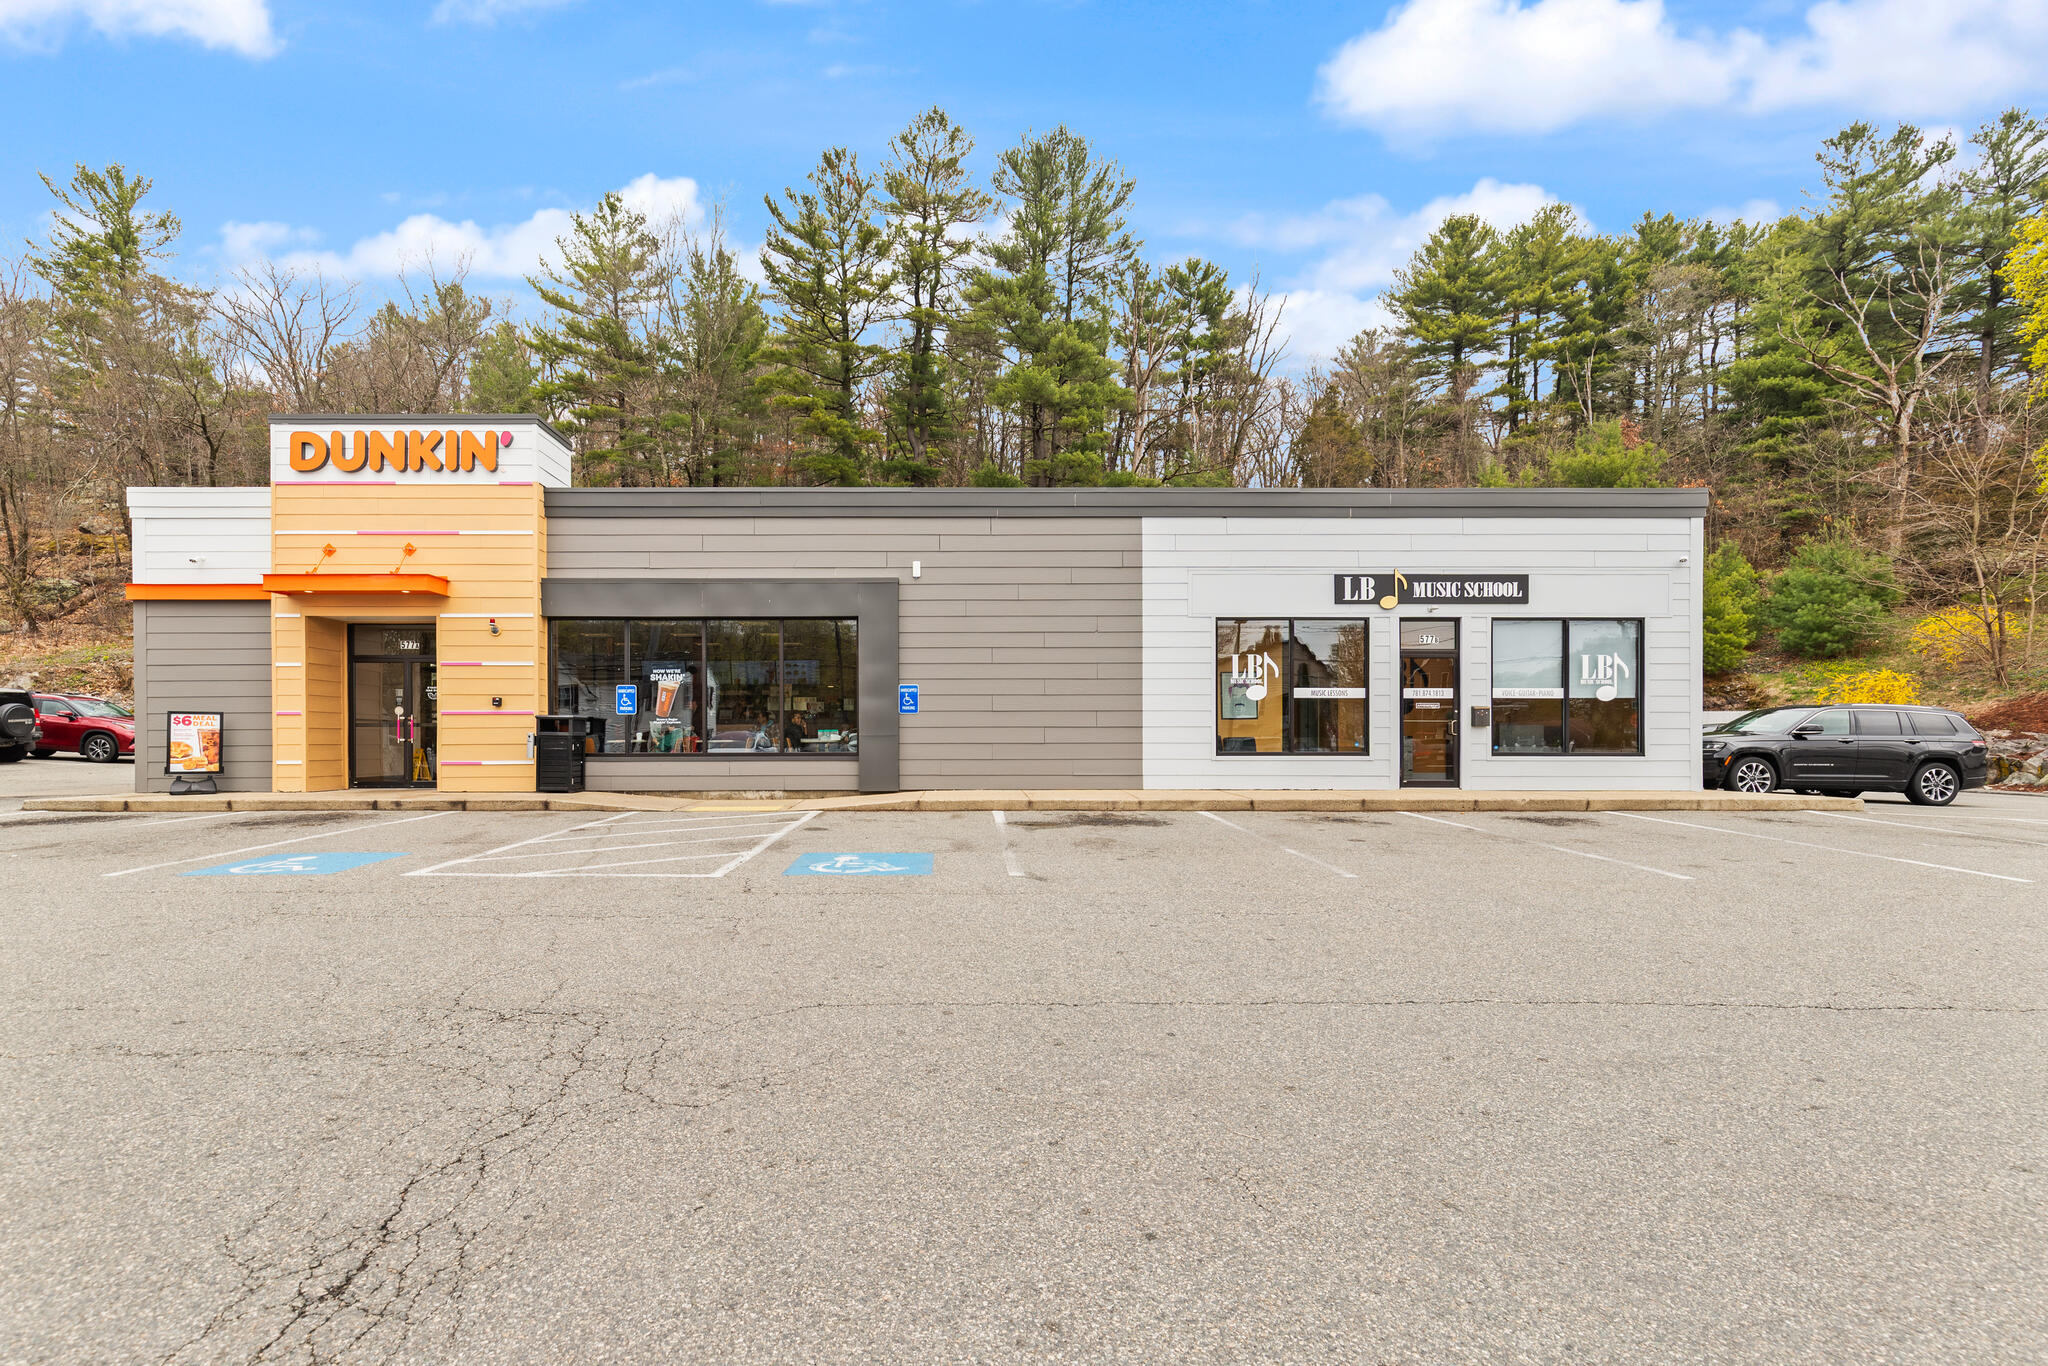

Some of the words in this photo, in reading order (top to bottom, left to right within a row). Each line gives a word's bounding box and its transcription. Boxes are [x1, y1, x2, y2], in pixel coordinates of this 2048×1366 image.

[290, 430, 513, 473] DUNKIN'
[1342, 576, 1376, 601] LB
[1413, 581, 1461, 598] MUSIC
[1464, 581, 1523, 598] SCHOOL
[650, 673, 686, 681] SHAKIN'
[1231, 654, 1263, 678] LB
[1580, 654, 1613, 680] LB
[1311, 689, 1327, 697] MUSIC
[1327, 689, 1349, 697] LESSONS
[173, 715, 192, 726] $6
